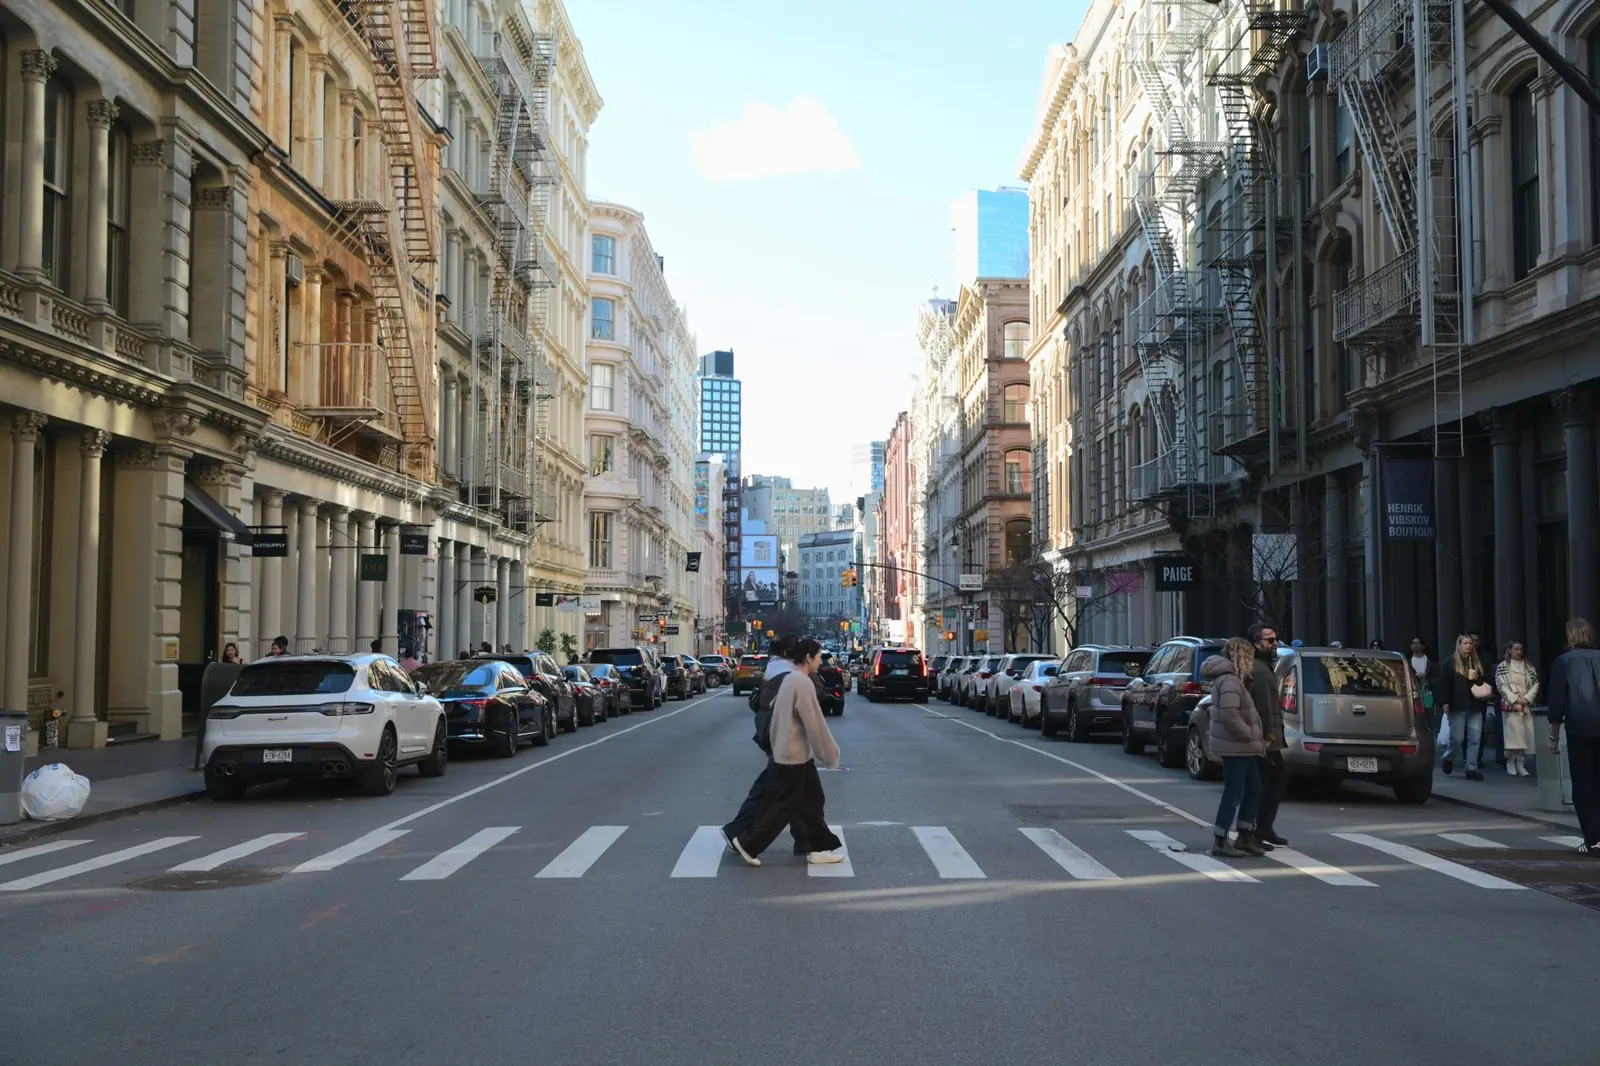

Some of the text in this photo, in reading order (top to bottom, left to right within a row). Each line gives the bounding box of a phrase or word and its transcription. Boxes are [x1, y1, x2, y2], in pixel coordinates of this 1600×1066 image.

[1388, 503, 1424, 514] HENRIK
[1389, 515, 1430, 525] VIBSKOV
[1389, 526, 1435, 537] BOUTIQUE
[1163, 566, 1194, 582] PAIGE
